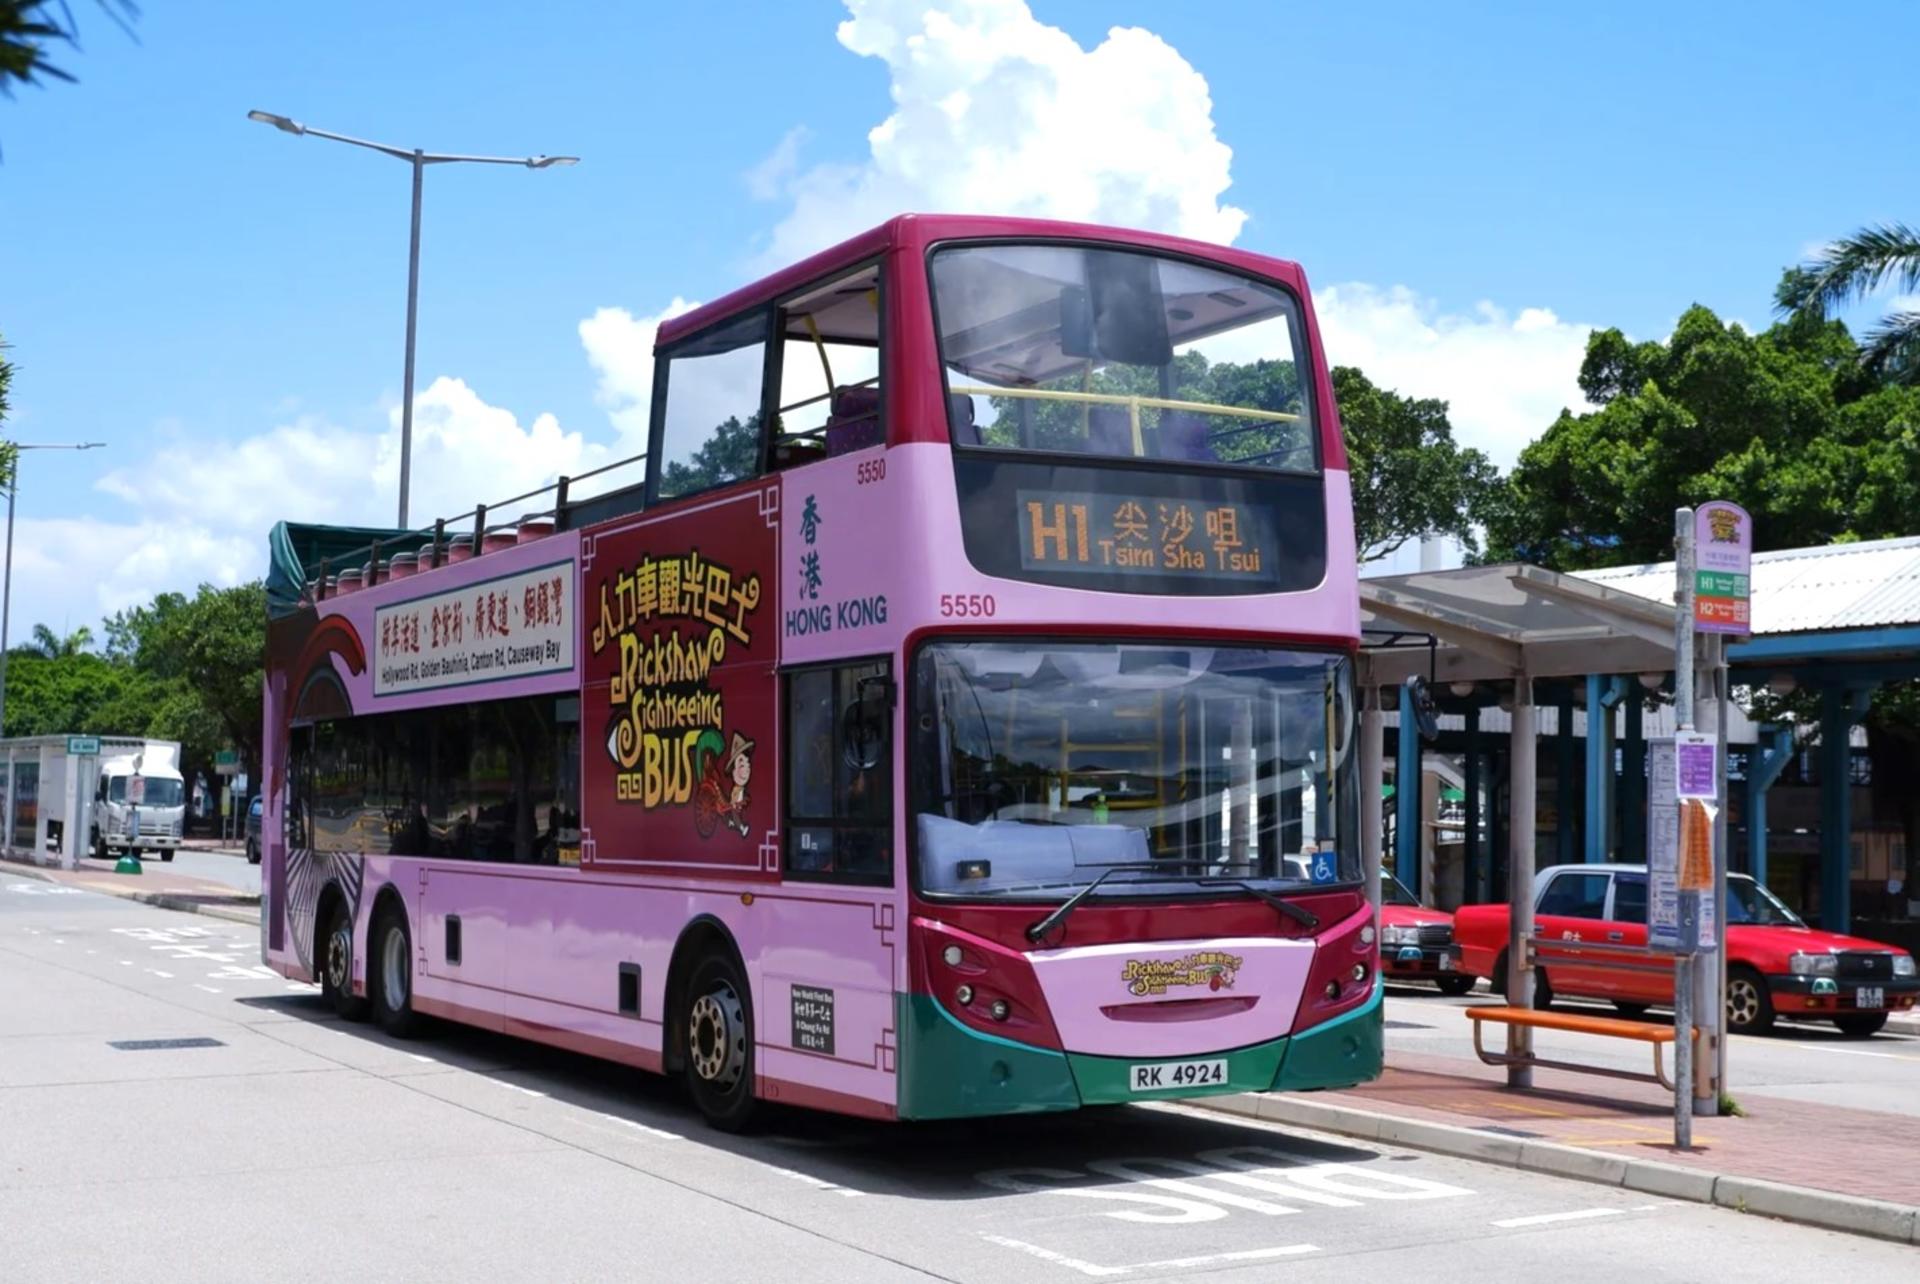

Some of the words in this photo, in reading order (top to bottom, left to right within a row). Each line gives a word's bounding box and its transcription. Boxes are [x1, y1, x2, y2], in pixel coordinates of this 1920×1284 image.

[857, 458, 887, 485] 5550
[1027, 501, 1089, 561] H1
[1113, 501, 1242, 547] 尖沙咀
[799, 494, 823, 600] 香港
[1098, 540, 1155, 567] Tsim
[1162, 544, 1206, 569] Sha
[1214, 547, 1261, 572] Tsui
[592, 551, 761, 653] 人力車觀光巴士
[1700, 576, 1714, 590] H1
[786, 605, 832, 637] HONG
[838, 595, 888, 629] KONG
[940, 594, 996, 617] 5550
[1700, 602, 1714, 615] H2
[421, 658, 441, 680] Golden
[471, 651, 494, 671] Canton
[507, 643, 544, 667] Causeway
[545, 639, 561, 664] Bay
[611, 627, 725, 704] Rickshaw
[617, 688, 723, 769] Sightseeing
[643, 730, 701, 809] BUS
[1122, 959, 1184, 981] Rickshaw
[1137, 1066, 1163, 1087] RK
[1172, 1063, 1222, 1084] 4924
